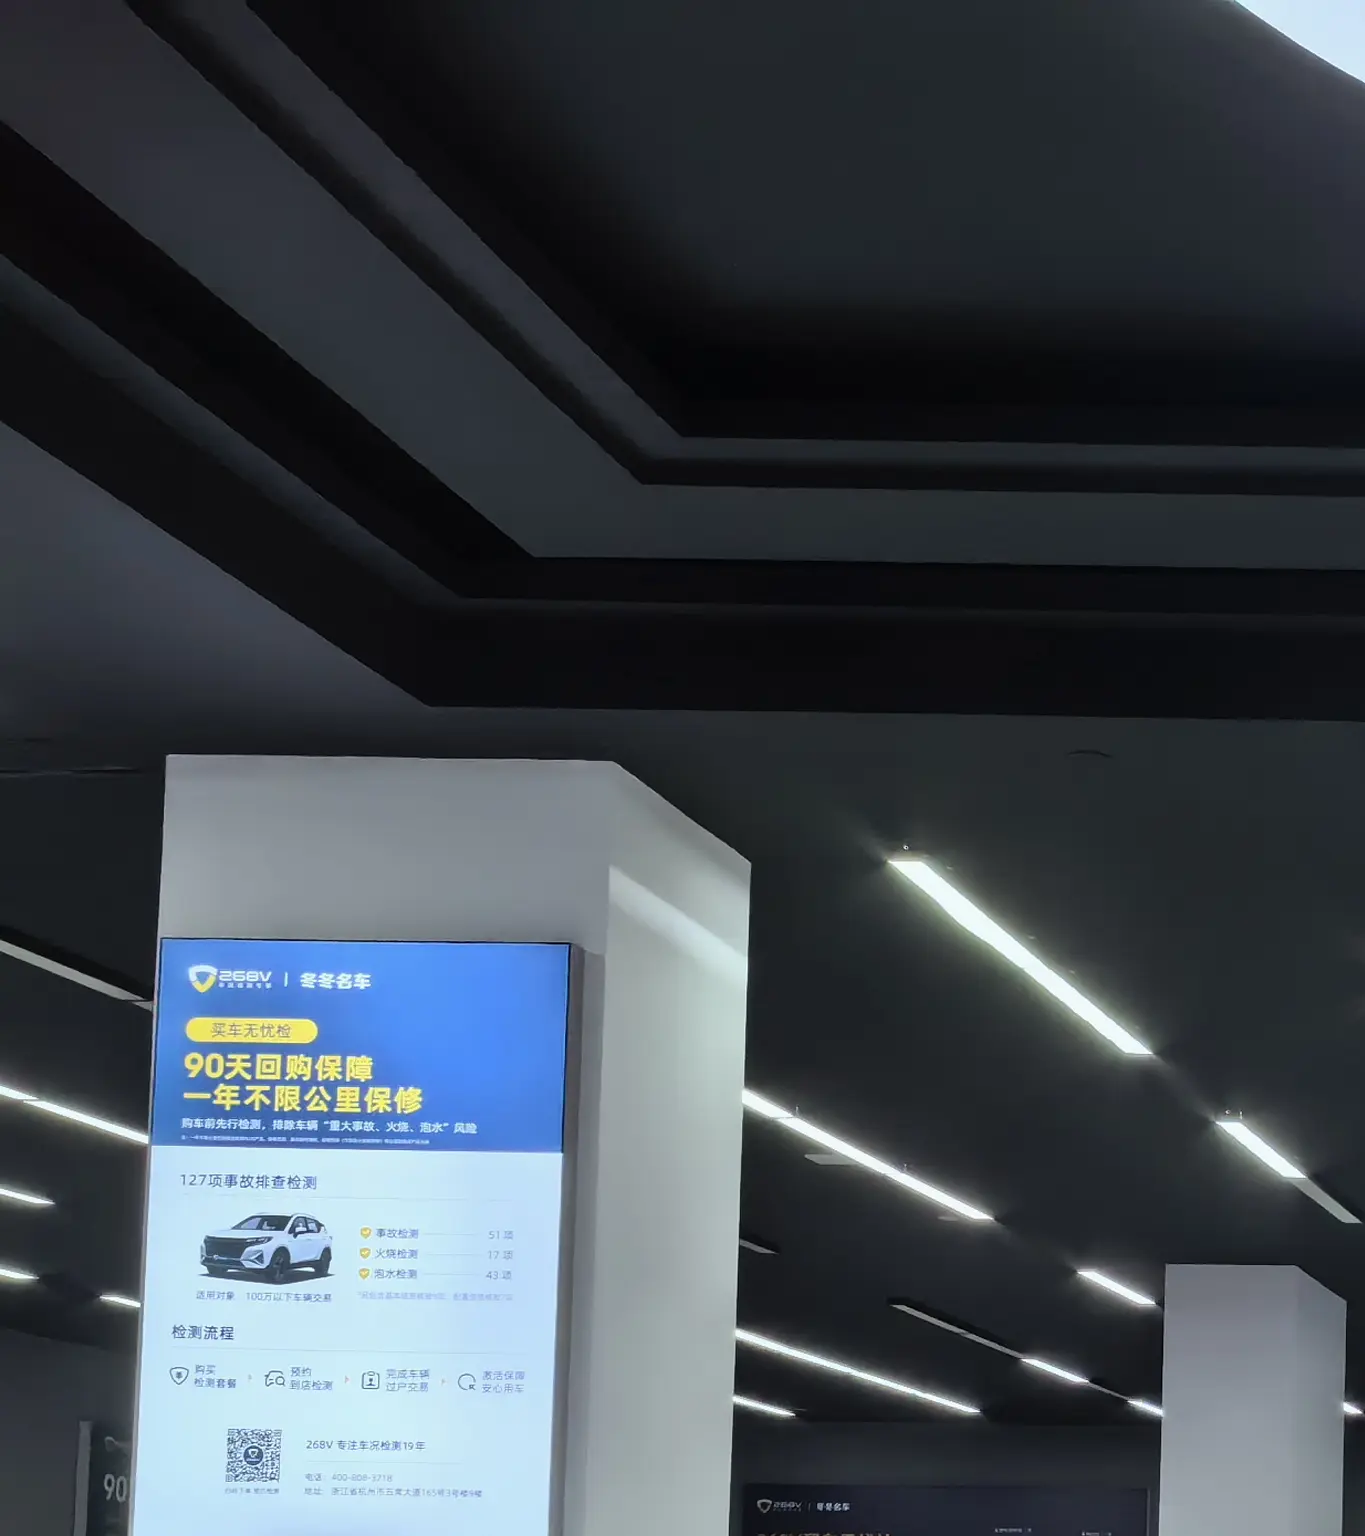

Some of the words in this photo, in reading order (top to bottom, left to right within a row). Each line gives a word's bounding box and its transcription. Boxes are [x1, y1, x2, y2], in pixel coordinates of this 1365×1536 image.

[219, 970, 272, 982] 268V
[300, 973, 372, 990] 冬冬名车
[212, 1022, 292, 1039] 买车无忧检
[184, 1053, 374, 1082] 90天回购保障
[183, 1084, 423, 1114] 一年不限公里保修
[180, 1173, 318, 1191] 127项事故排查检测
[376, 1228, 419, 1239] 事故检测
[488, 1230, 501, 1240] 51
[374, 1249, 419, 1260] 火烧检测
[488, 1250, 500, 1260] 17
[374, 1269, 418, 1280] 泡水检测
[171, 1324, 235, 1341] 检测流程
[195, 1364, 216, 1376] 购买
[290, 1367, 312, 1378] 预约
[386, 1368, 430, 1380] 完成车辆
[482, 1370, 526, 1381] 激活保障
[194, 1378, 237, 1389] 检测套餐
[289, 1380, 333, 1391] 到店检测
[386, 1381, 429, 1392] 过户交易
[482, 1383, 525, 1394] 安心用车
[306, 1440, 334, 1450] 268V
[337, 1440, 425, 1452] 专注车况检测19年
